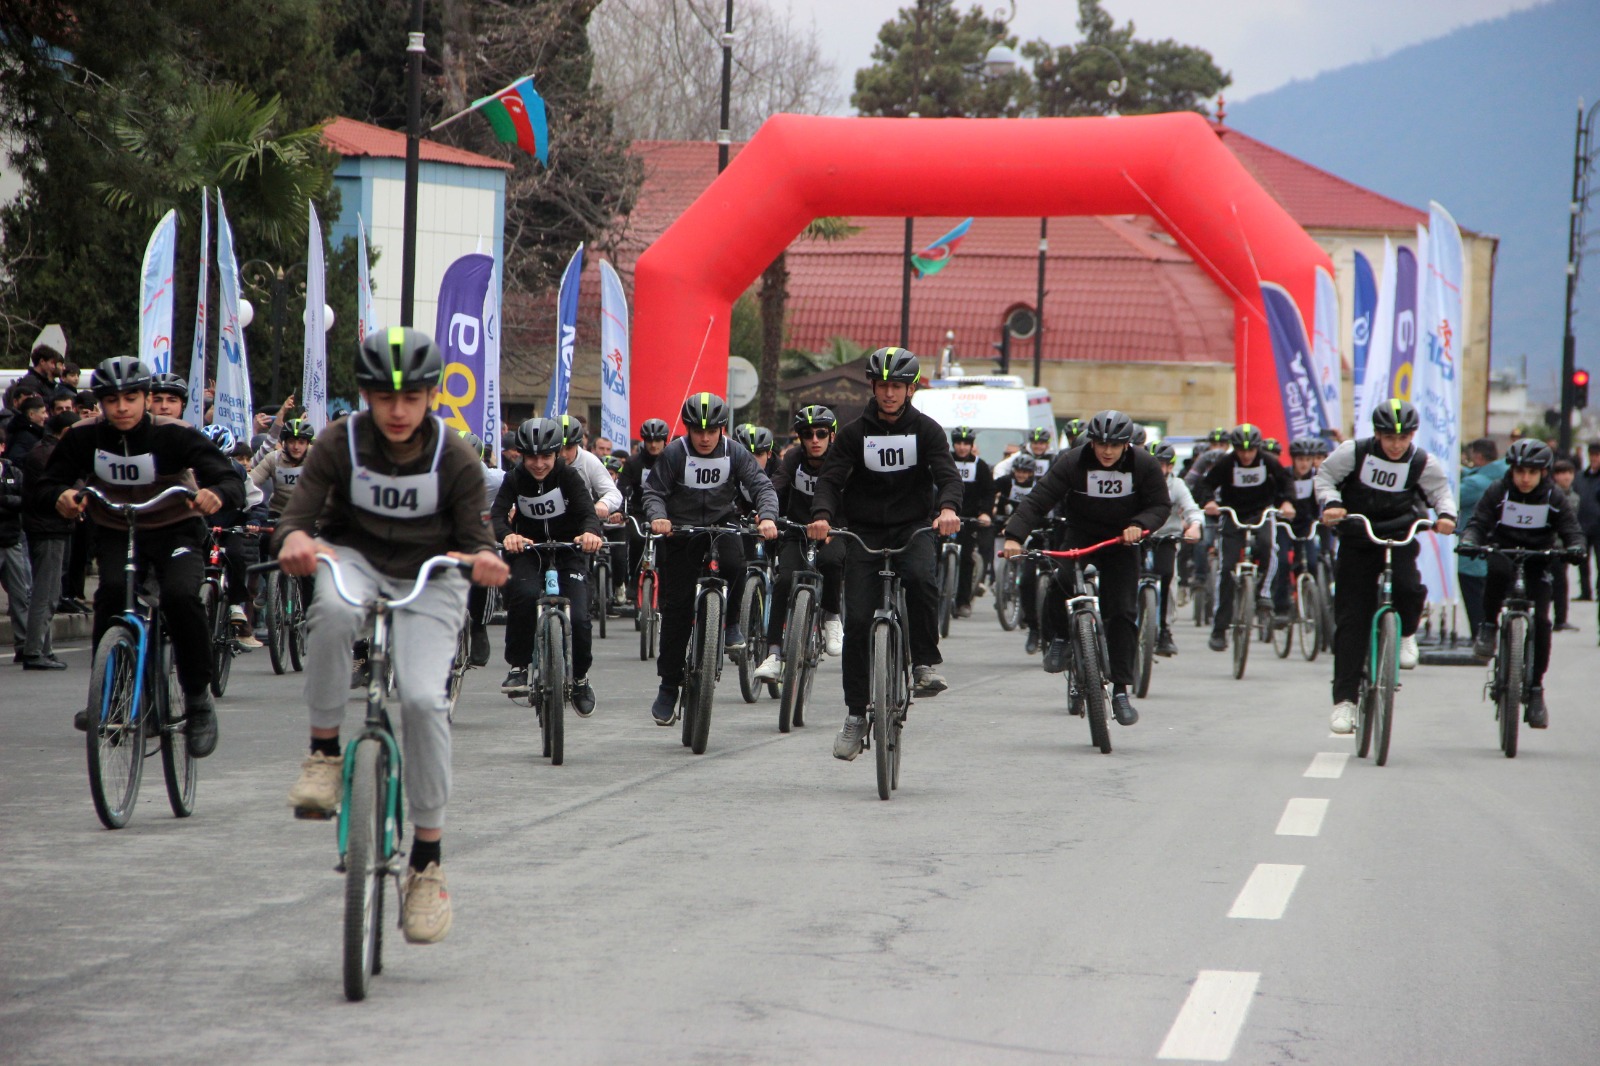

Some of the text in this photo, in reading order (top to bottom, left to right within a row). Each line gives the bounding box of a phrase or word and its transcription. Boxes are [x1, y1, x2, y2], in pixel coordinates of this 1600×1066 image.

[878, 447, 905, 467] 101
[109, 463, 139, 481] 110
[695, 468, 721, 484] 108
[1371, 468, 1397, 487] 100
[804, 480, 816, 493] 11
[1097, 480, 1122, 494] 123
[370, 484, 418, 511] 104
[528, 499, 556, 516] 103
